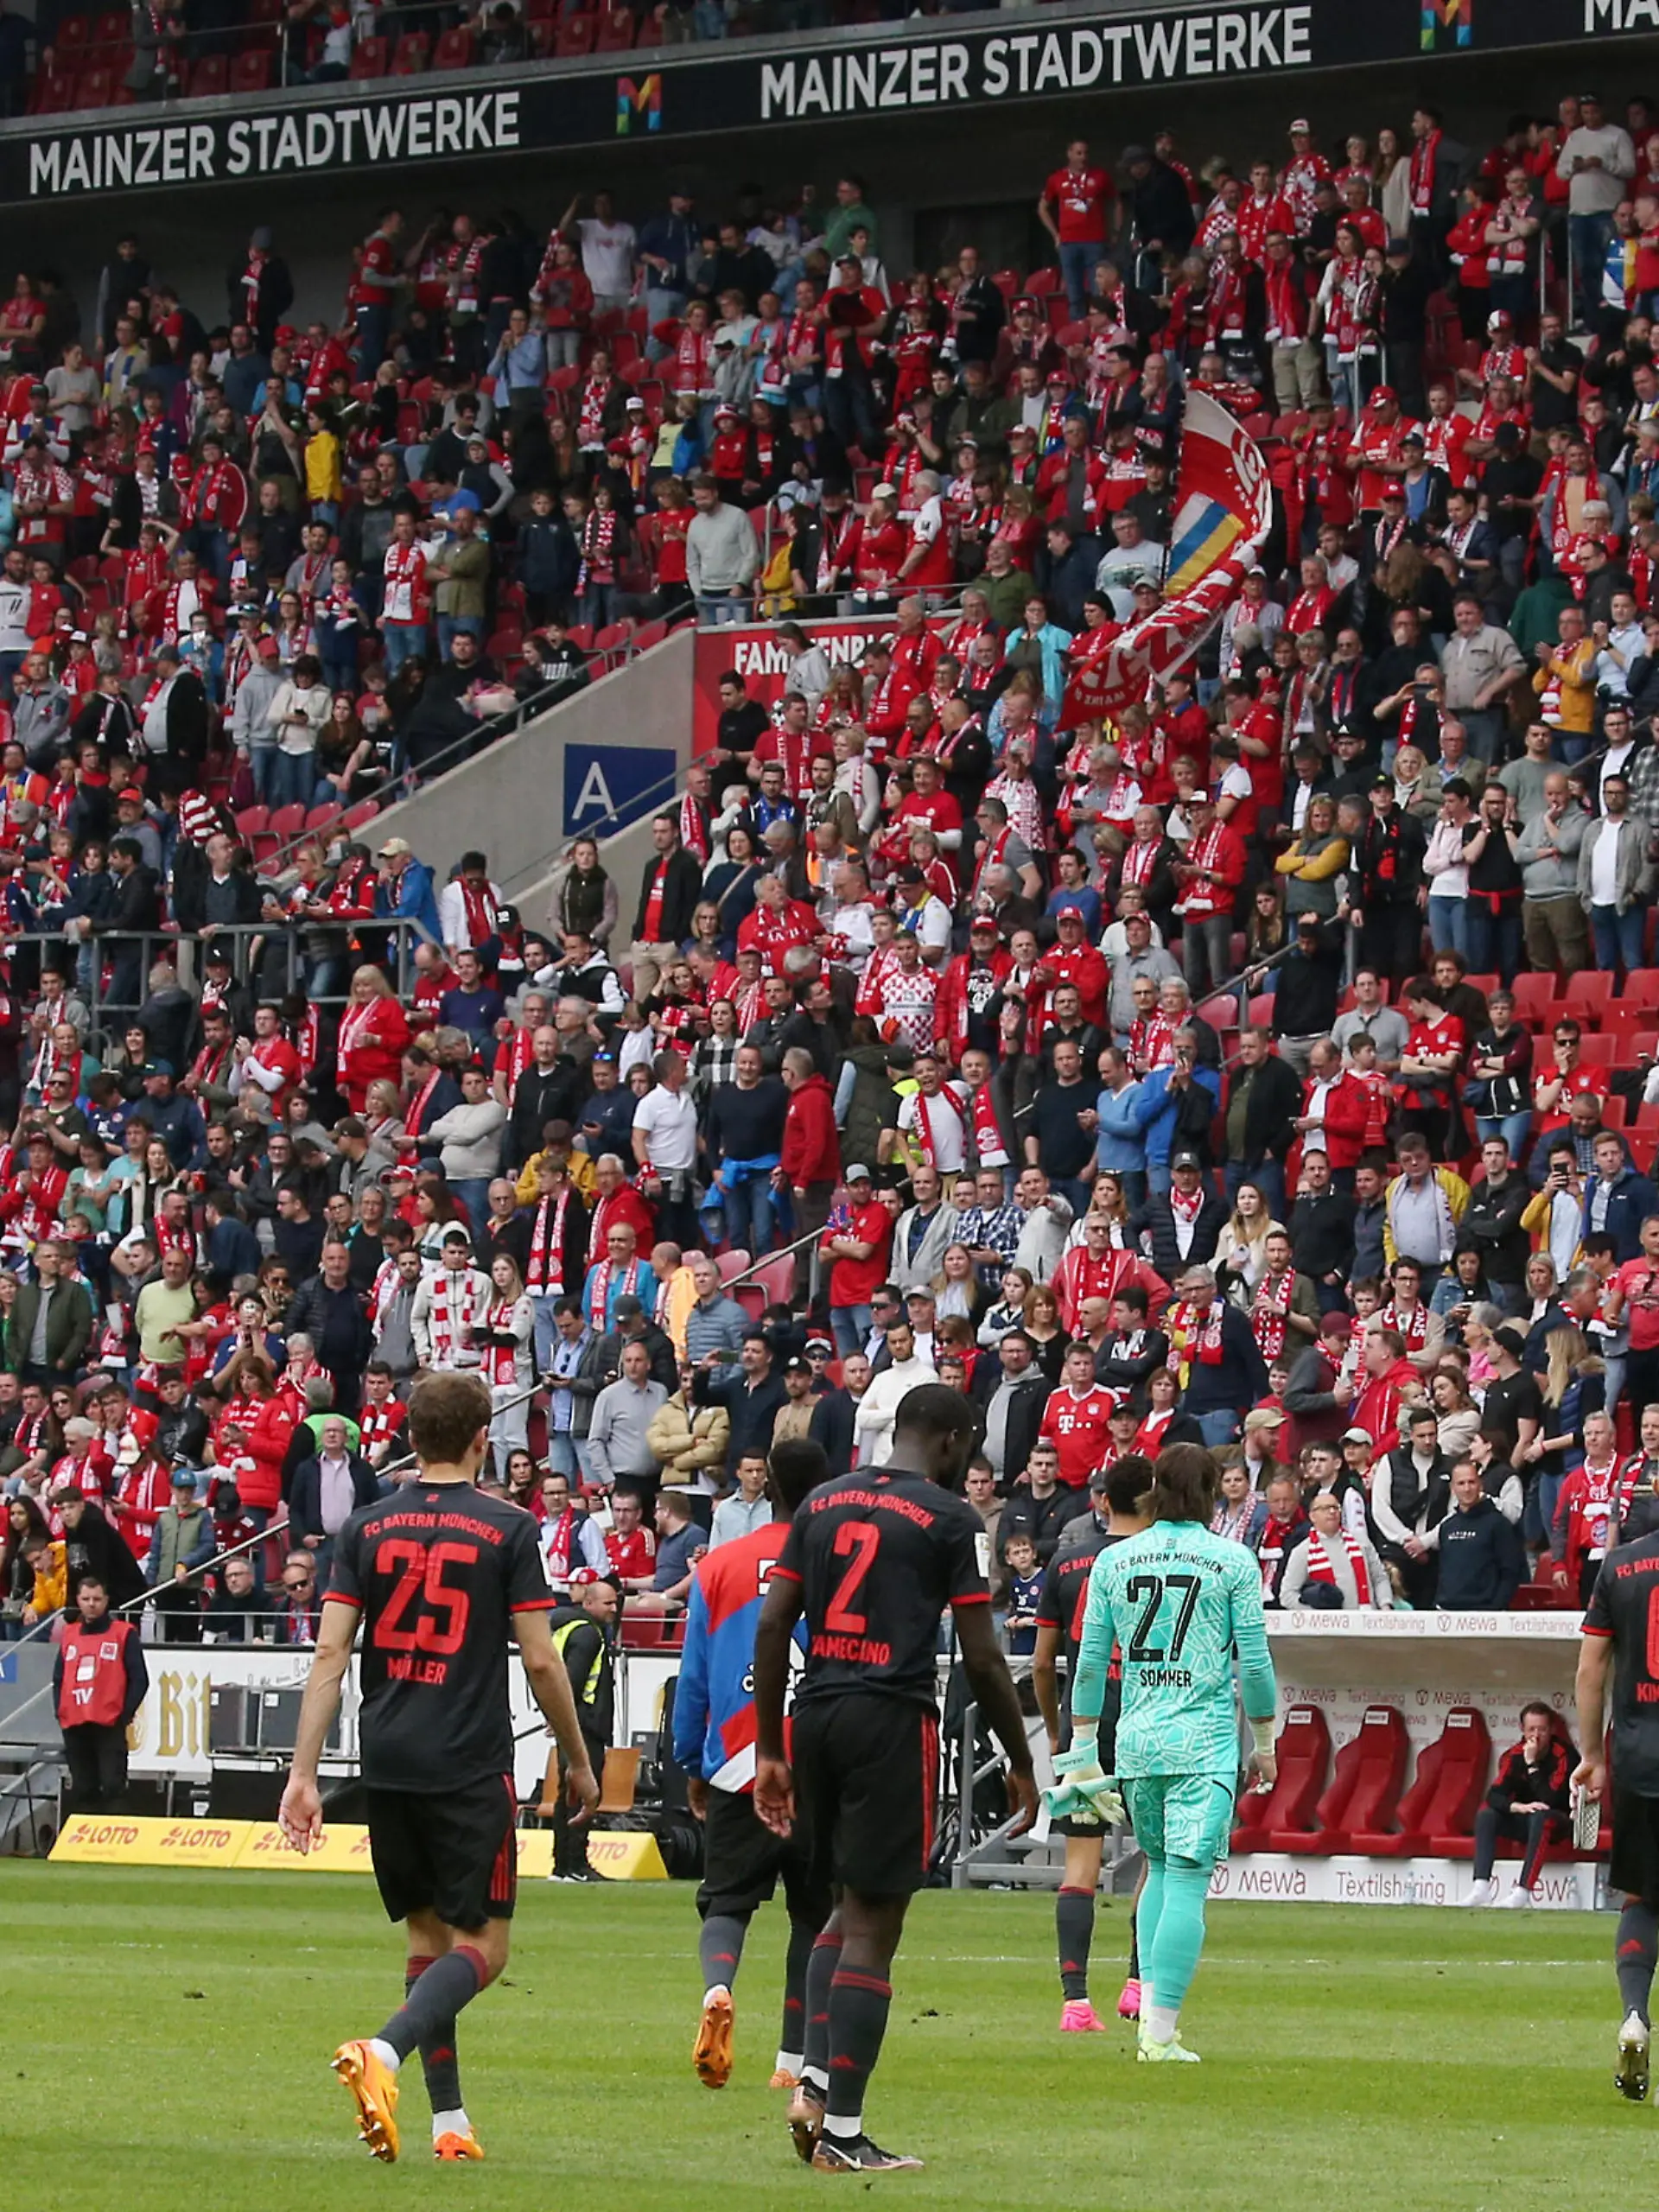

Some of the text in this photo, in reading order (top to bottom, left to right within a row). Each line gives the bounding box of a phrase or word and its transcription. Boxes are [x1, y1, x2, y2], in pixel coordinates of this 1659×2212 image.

[760, 5, 1313, 120] MAINZER STADTWERKE
[29, 91, 521, 195] MAINZER STADTWERKE
[571, 760, 619, 823] A
[810, 1491, 936, 1529] FC BAYERN MÜNCHEN
[363, 1512, 505, 1546] FC BAYERN MÜNCHEN
[1058, 1561, 1071, 1577] FC
[1114, 1552, 1224, 1575] FC BAYERN MÜNCHEN
[1615, 1563, 1632, 1580] FC
[824, 1520, 880, 1635] 2
[372, 1538, 479, 1656] 25
[1126, 1573, 1202, 1662] 27
[1362, 1614, 1426, 1634] Textilsharing
[1509, 1617, 1575, 1636] Textilsharing
[1139, 1669, 1192, 1688] SOMMER
[71, 1687, 94, 1707] TV
[88, 1825, 139, 1845] LOTTO
[181, 1828, 232, 1848] LOTTO
